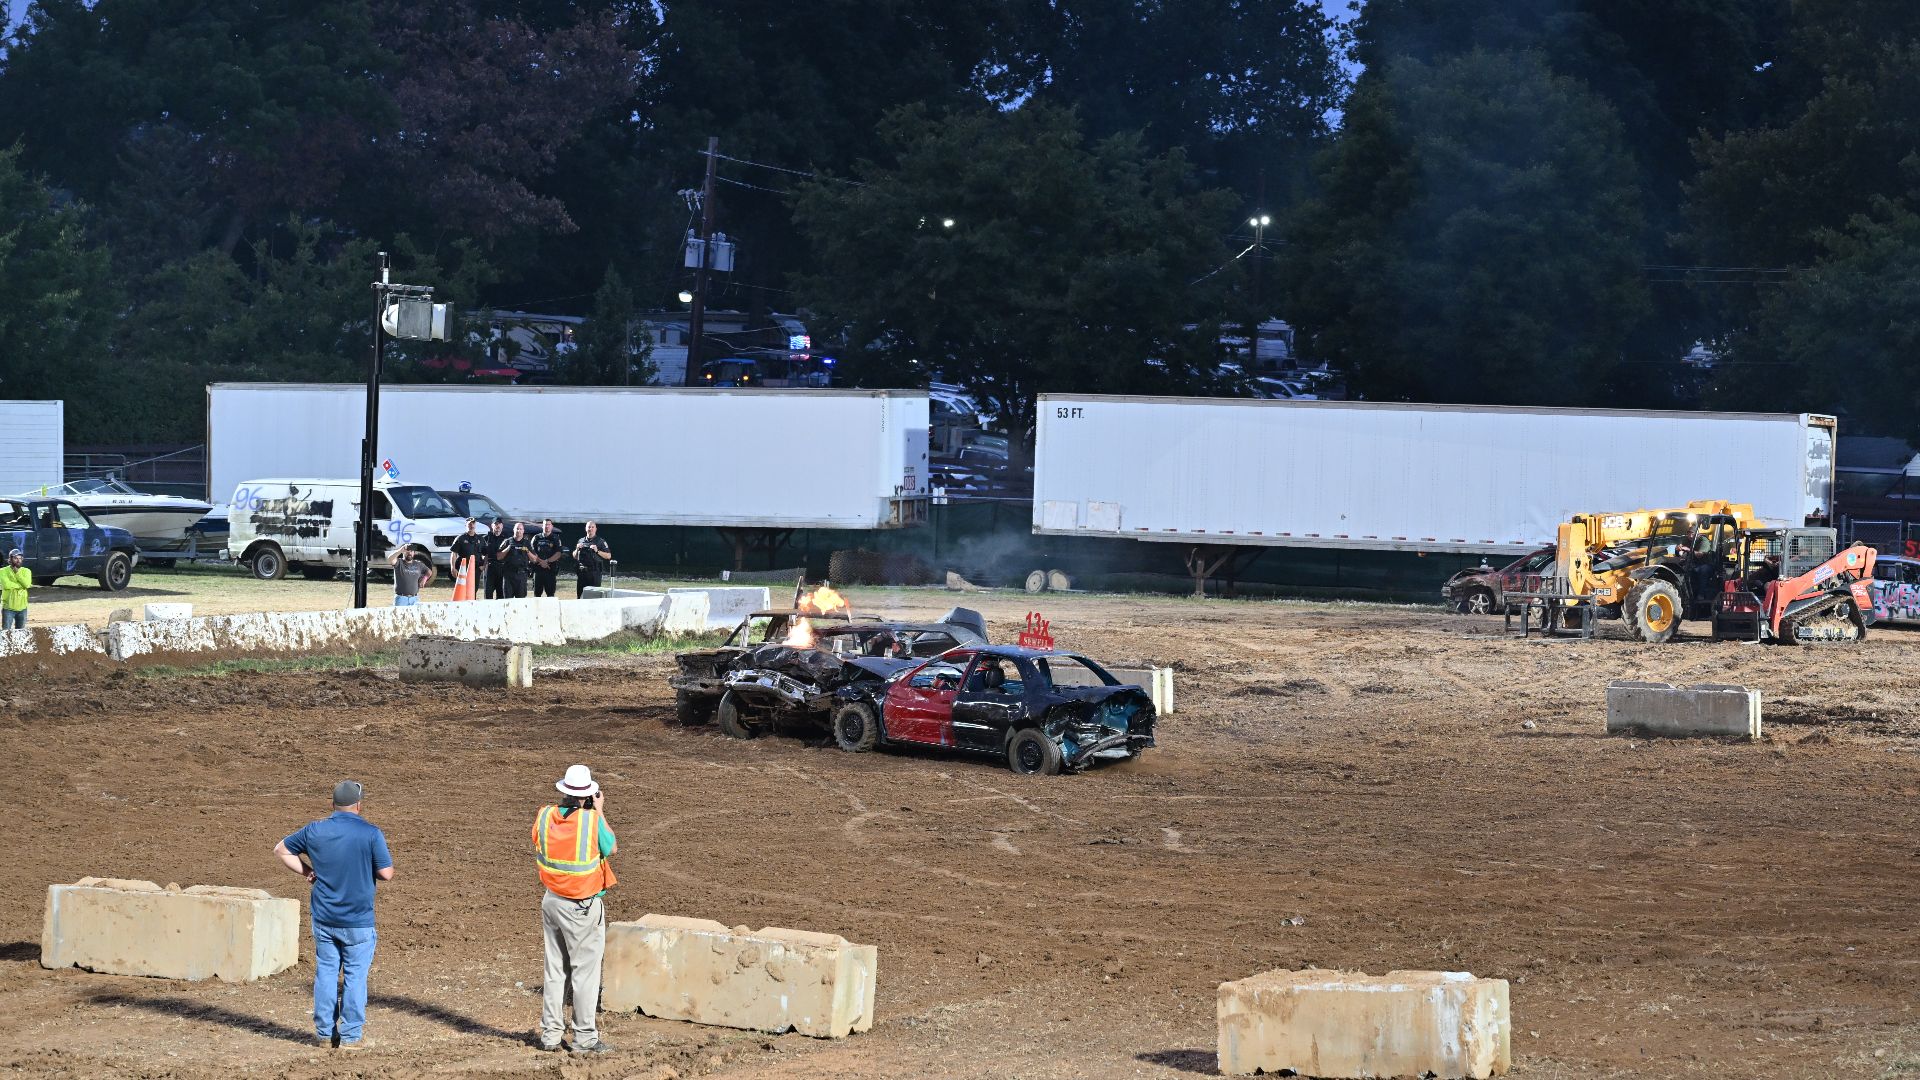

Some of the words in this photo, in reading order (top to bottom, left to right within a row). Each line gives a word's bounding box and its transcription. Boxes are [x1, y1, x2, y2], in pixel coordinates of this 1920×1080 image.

[1057, 407, 1068, 418] 53
[1071, 407, 1085, 418] FT.
[235, 487, 264, 511] 96
[389, 520, 415, 544] 96
